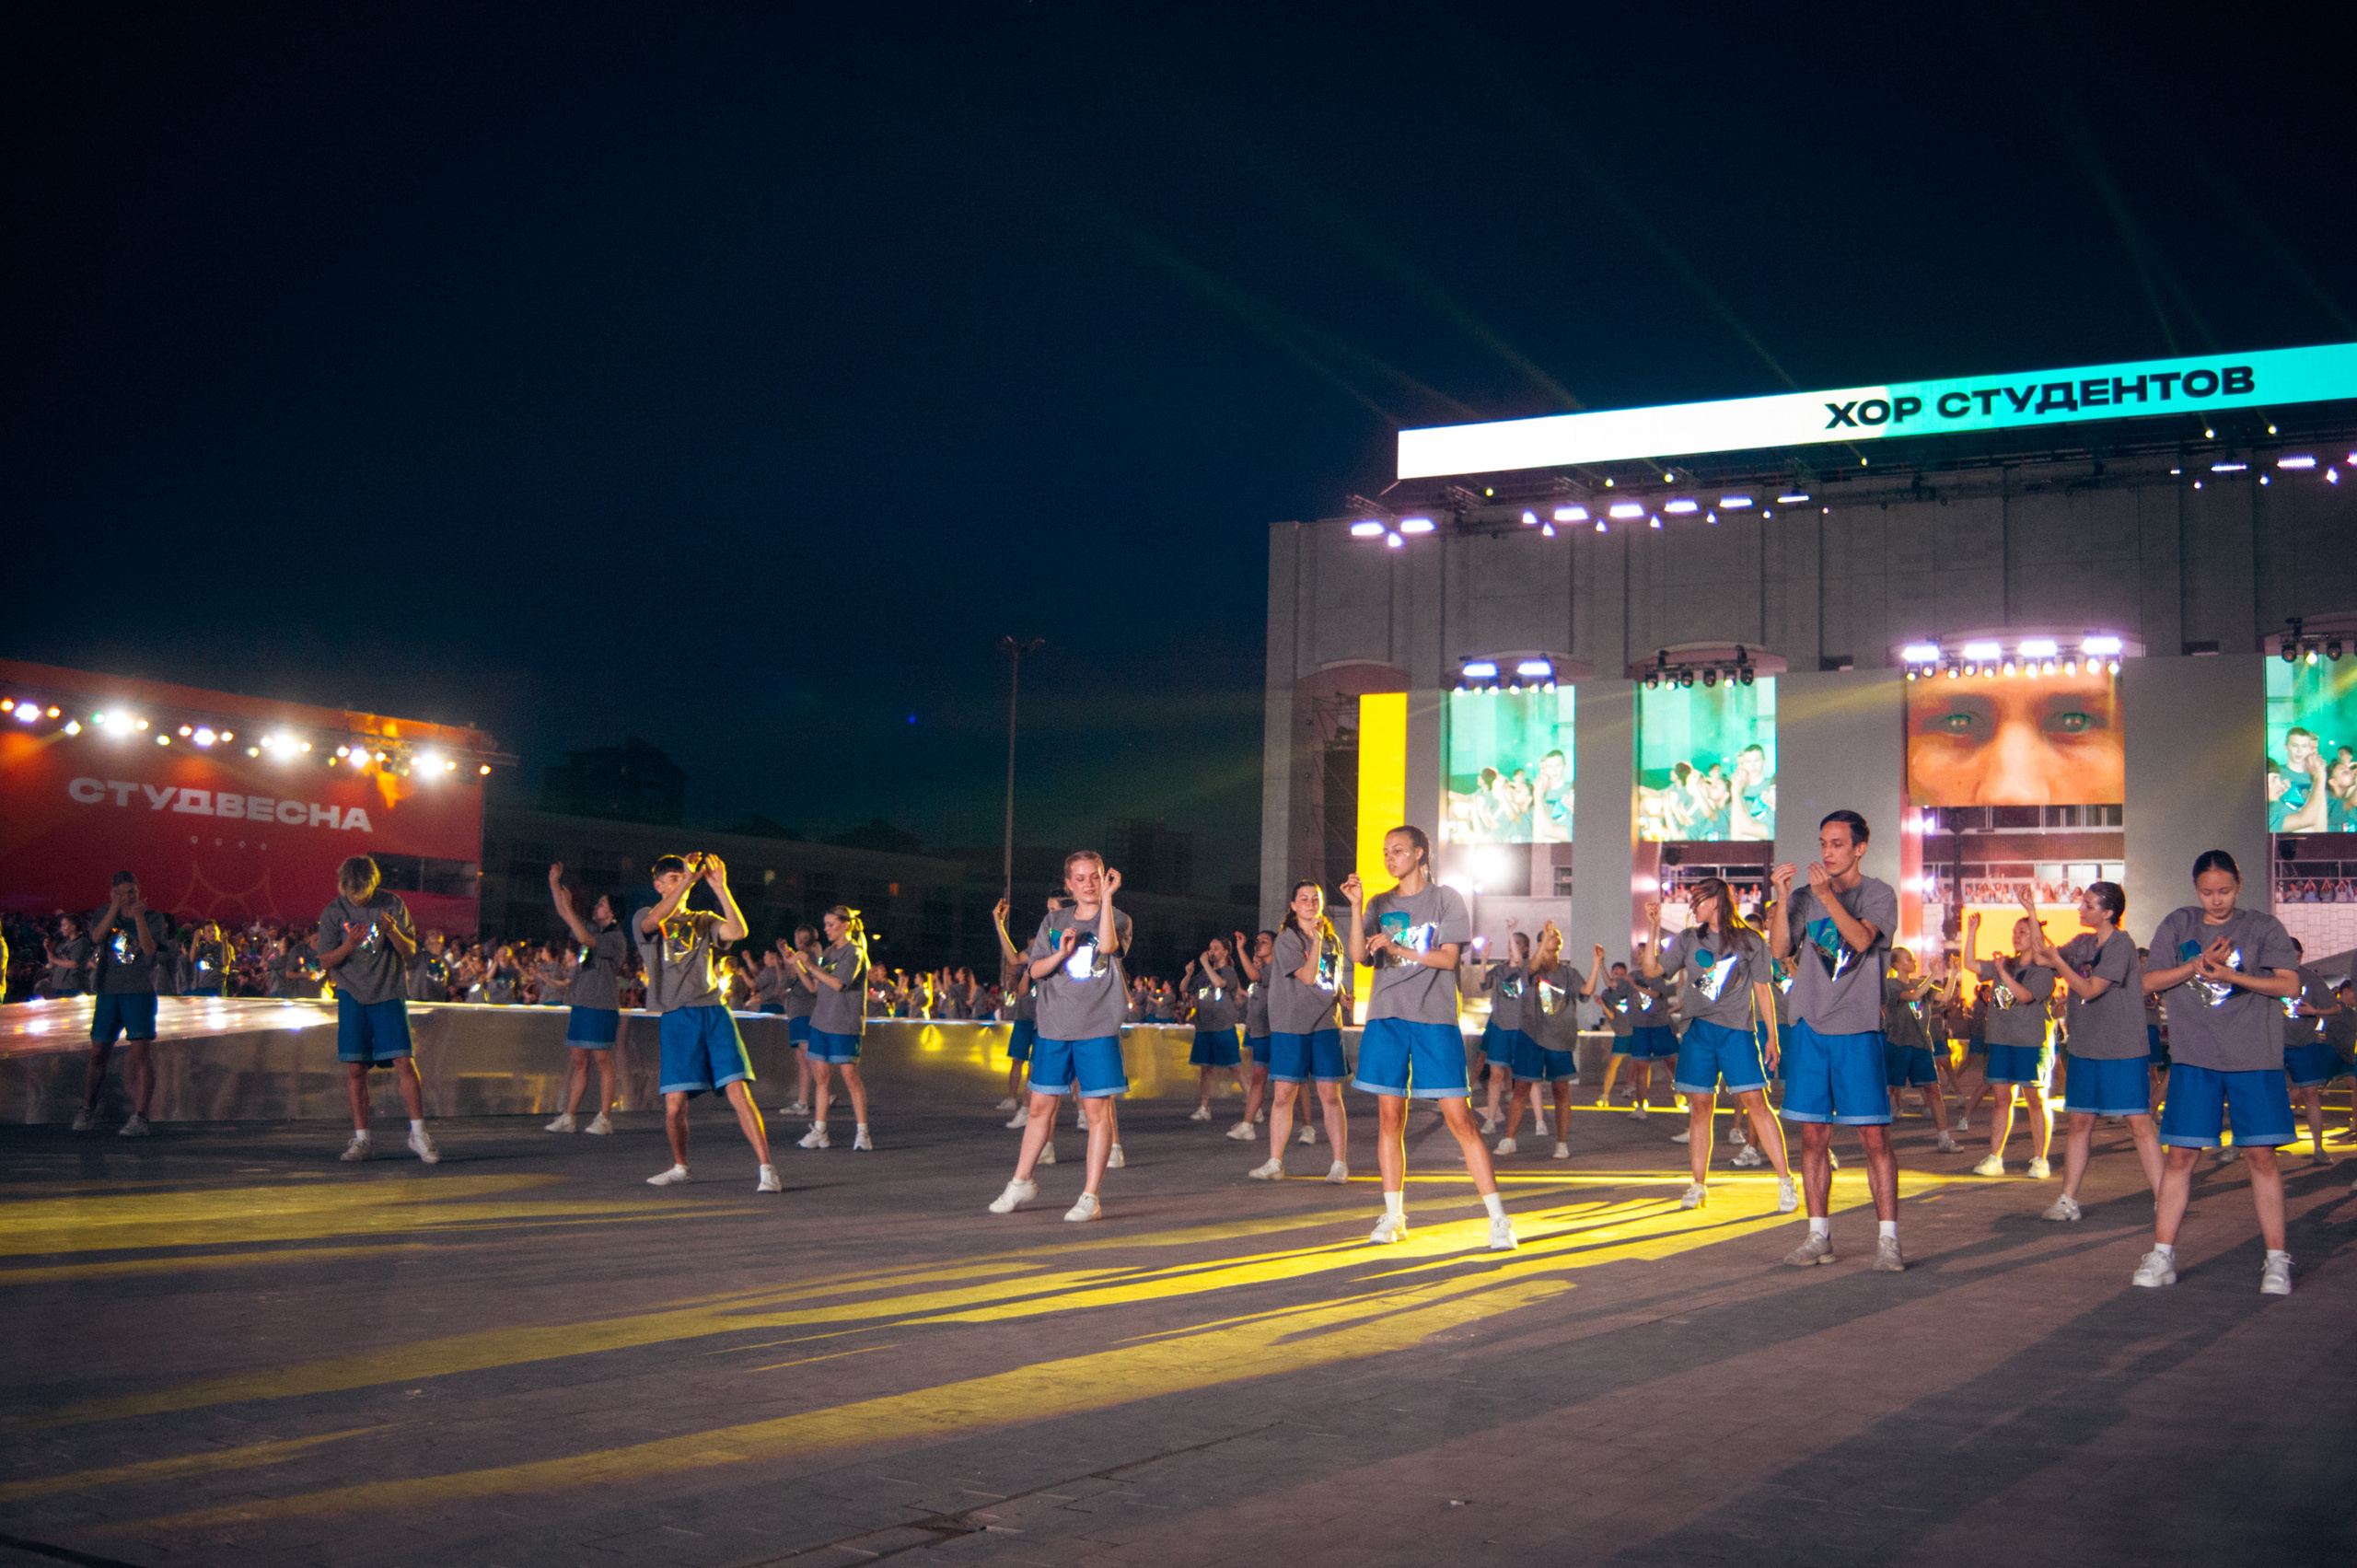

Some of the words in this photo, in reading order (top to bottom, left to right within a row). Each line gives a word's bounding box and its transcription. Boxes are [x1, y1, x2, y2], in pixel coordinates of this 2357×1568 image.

[1826, 396, 1922, 429] ХОР
[1937, 366, 2256, 419] СТУДЕНТОВ
[68, 776, 373, 832] СТУДВЕСНА
